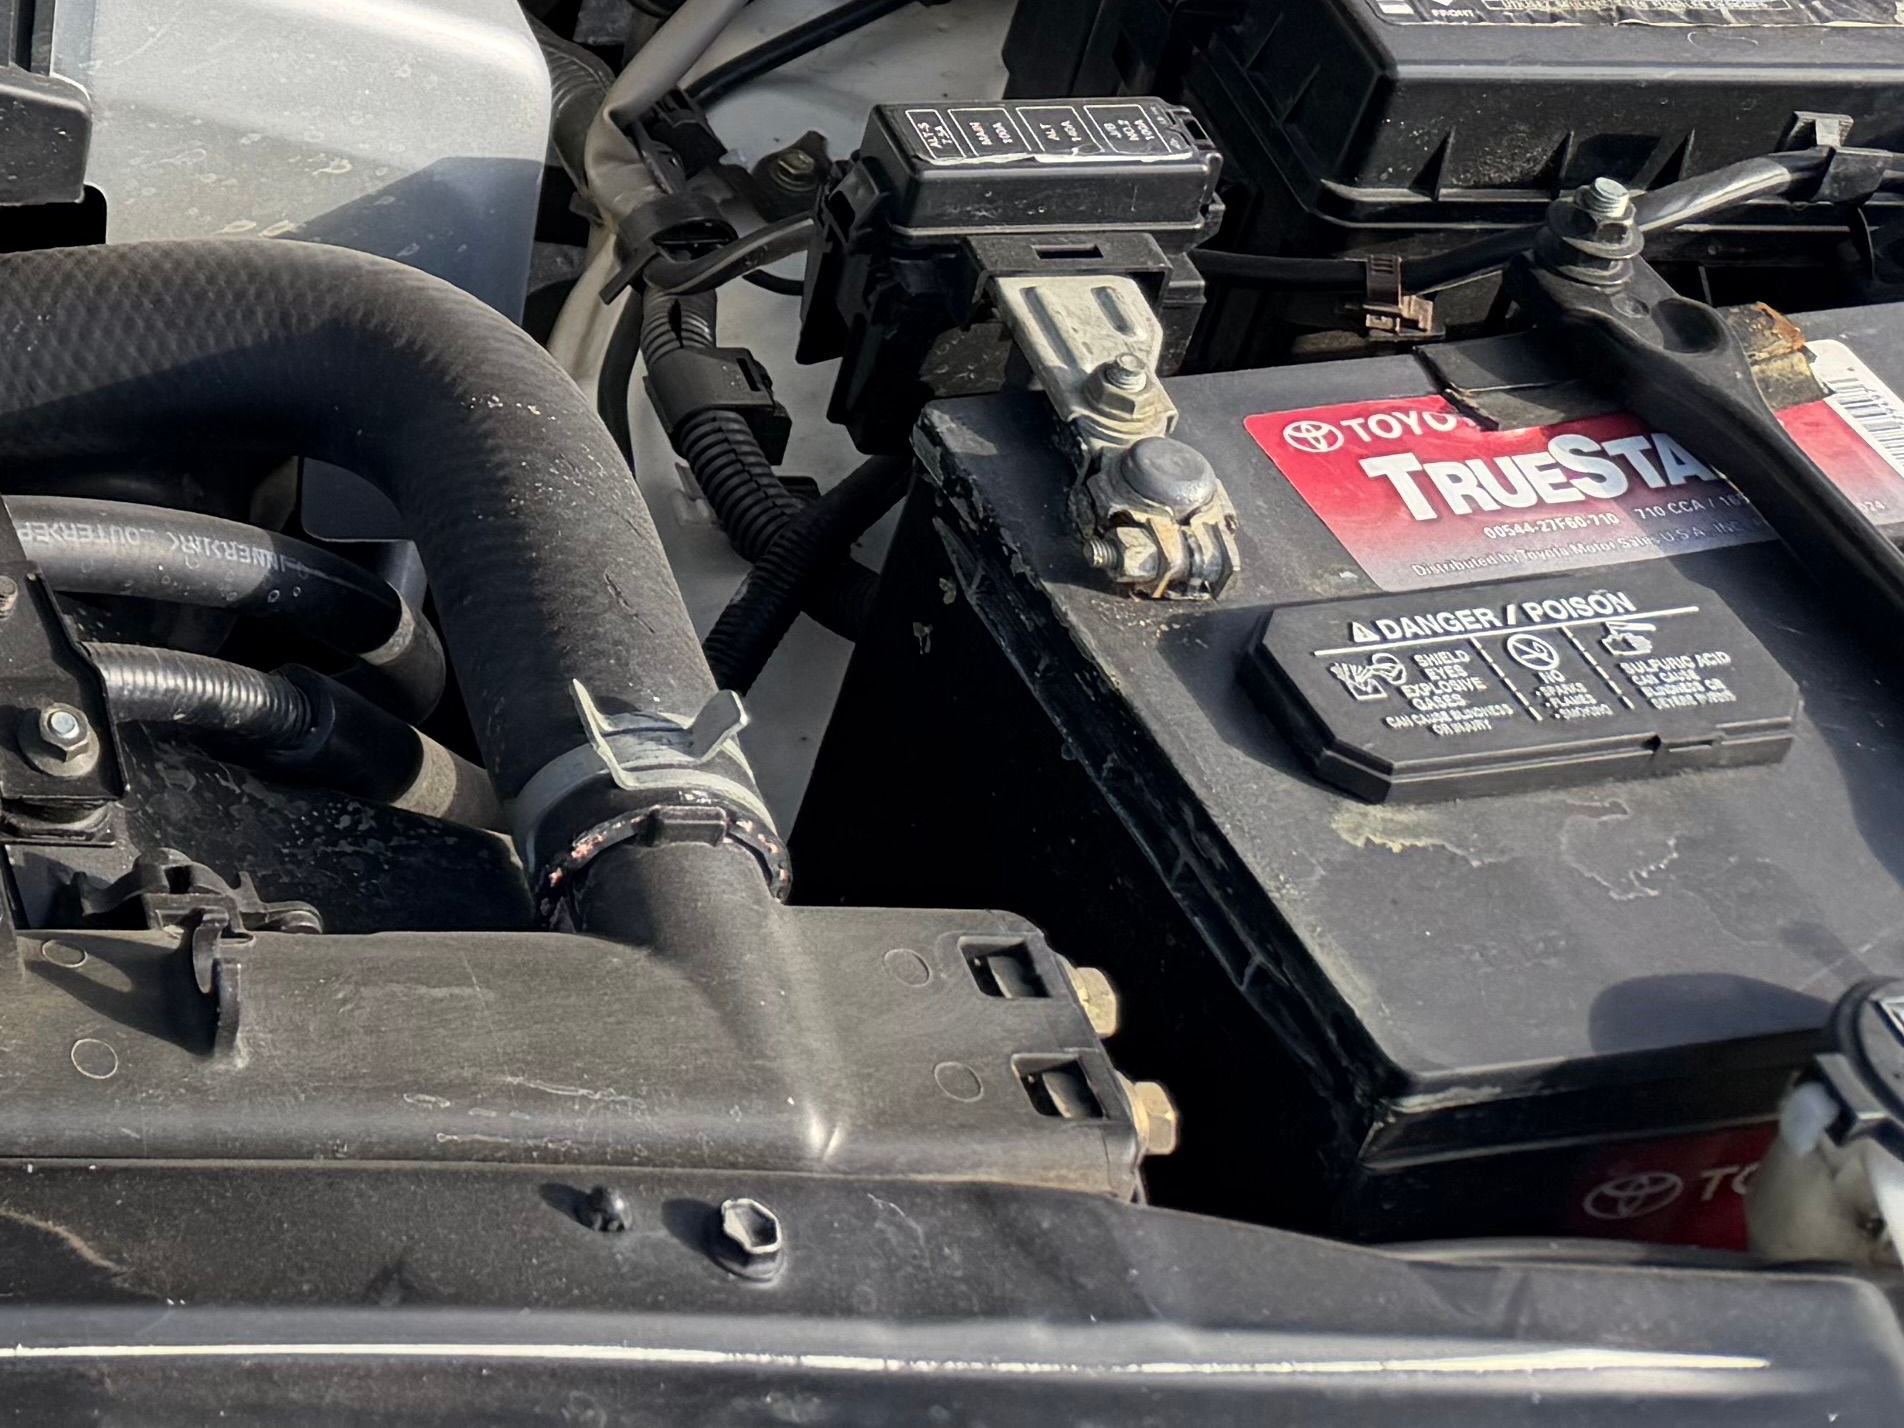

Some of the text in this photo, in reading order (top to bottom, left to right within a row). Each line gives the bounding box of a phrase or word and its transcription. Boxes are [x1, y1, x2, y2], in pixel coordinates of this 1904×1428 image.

[1432, 9, 1475, 17] FRONT
[918, 122, 942, 148] ALT-S
[969, 122, 992, 146] MAIN
[1040, 123, 1060, 142] ALT
[1341, 409, 1478, 443] TOYO
[1358, 431, 1723, 522] TRUESTA
[1634, 505, 1666, 520] 710
[1667, 500, 1705, 515] CCA
[1483, 511, 1619, 540] 00544-27F60-710
[1412, 539, 1616, 577] Distributed by Toyota Motor
[1374, 605, 1503, 641] DANGER
[1526, 591, 1637, 623] POISON
[1413, 648, 1471, 668] SHIELD
[1618, 651, 1731, 675] SULFURIC ACID
[1424, 665, 1469, 680] EYES
[1538, 671, 1565, 684] NO
[1629, 669, 1701, 687] CAN CAUSE
[1402, 677, 1488, 700] EXPLOSIVE
[1540, 682, 1589, 696] SPARKS
[1702, 678, 1726, 692] OR
[1411, 693, 1468, 710] GASES
[1550, 692, 1597, 707] FLAMES
[1385, 703, 1515, 730] CAN CAUSE BLINDNESS
[1559, 704, 1613, 721] SMOKING
[1431, 719, 1494, 737] OR INJURY
